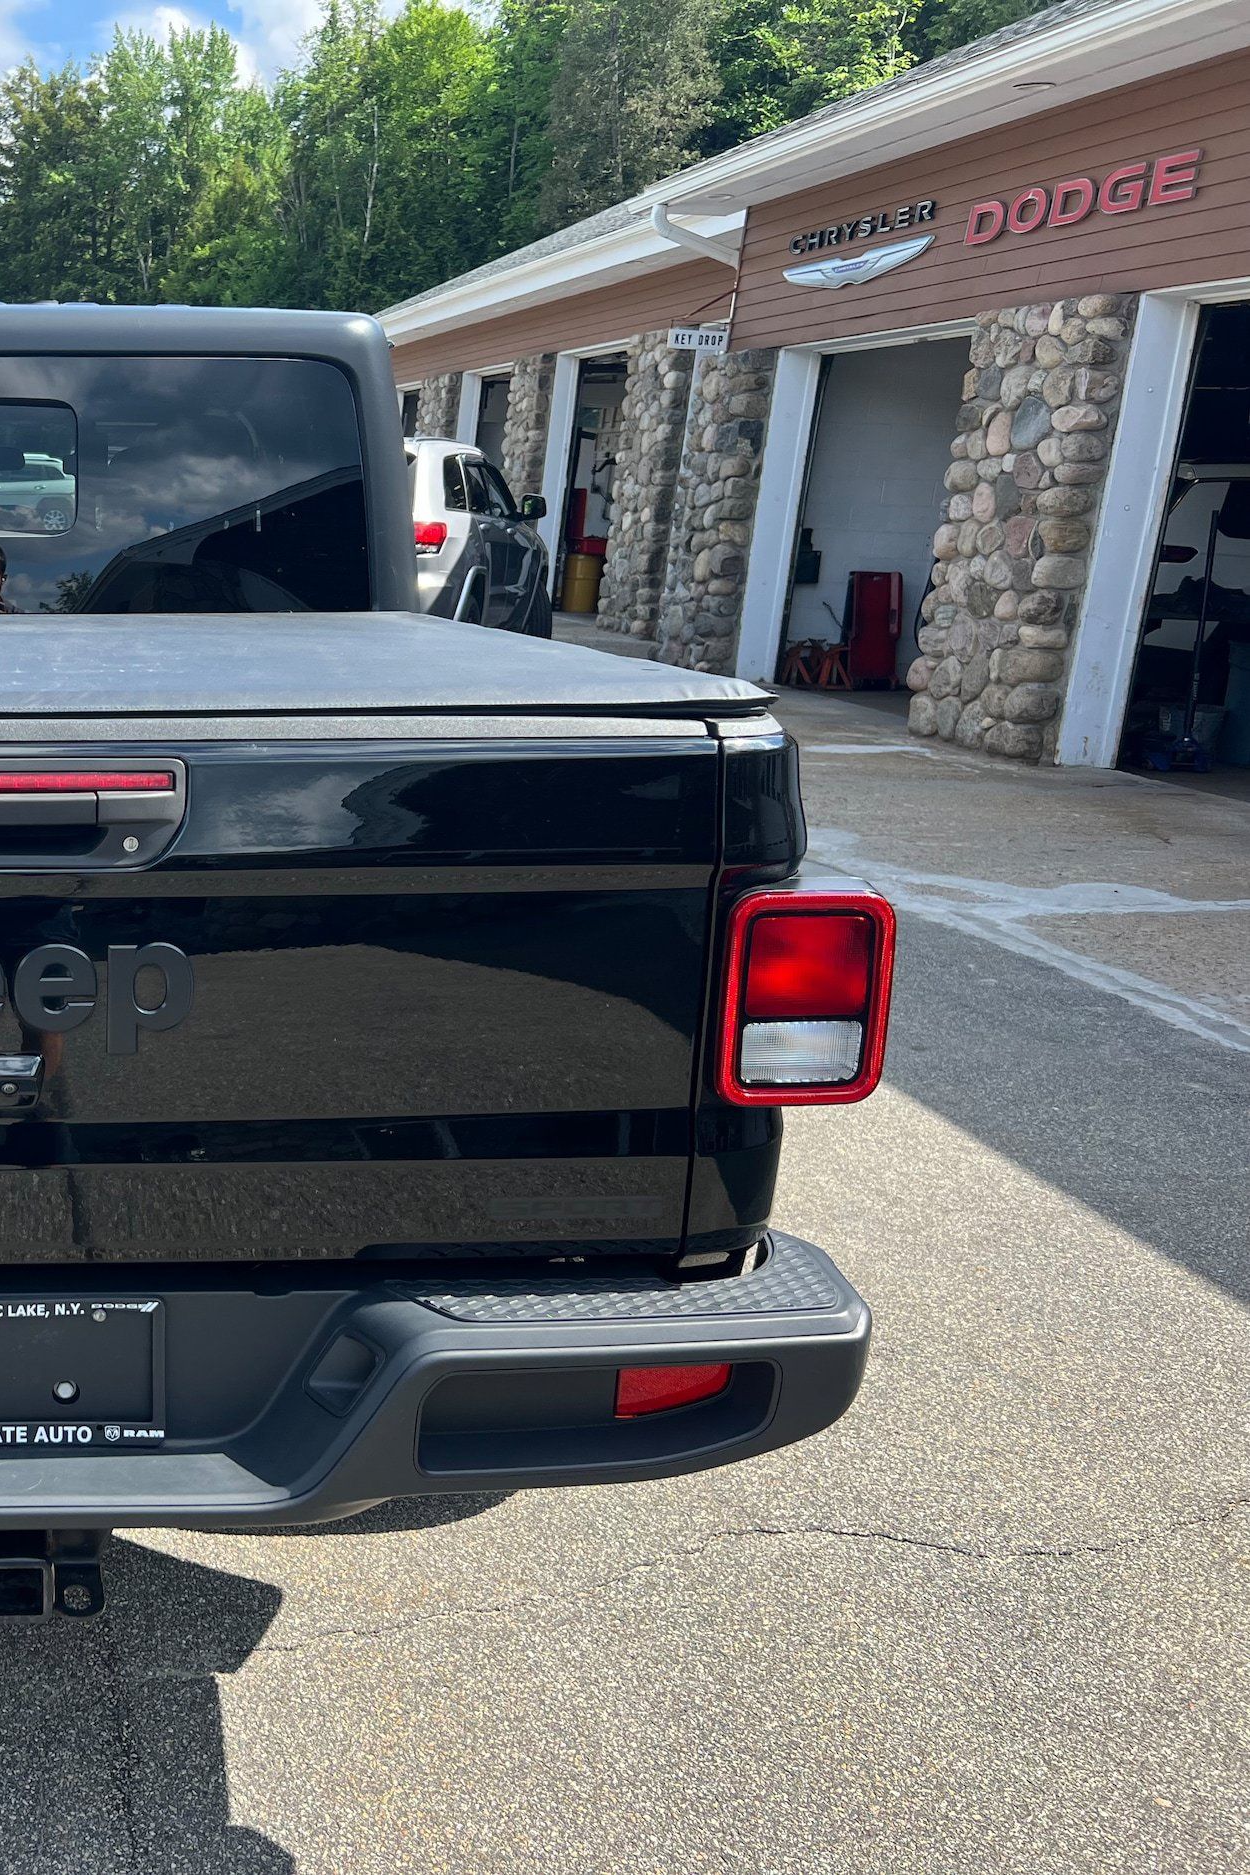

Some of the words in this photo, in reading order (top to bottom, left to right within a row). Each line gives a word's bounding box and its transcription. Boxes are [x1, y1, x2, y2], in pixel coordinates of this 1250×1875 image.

[963, 149, 1203, 246] DODGE
[789, 200, 934, 255] CHRYSLER
[674, 334, 692, 345] KEY
[698, 335, 723, 346] DROP
[7, 1304, 50, 1318] LAKE,
[54, 1303, 85, 1316] N.Y.
[34, 1425, 92, 1443] AUTO
[123, 1429, 165, 1438] RAM
